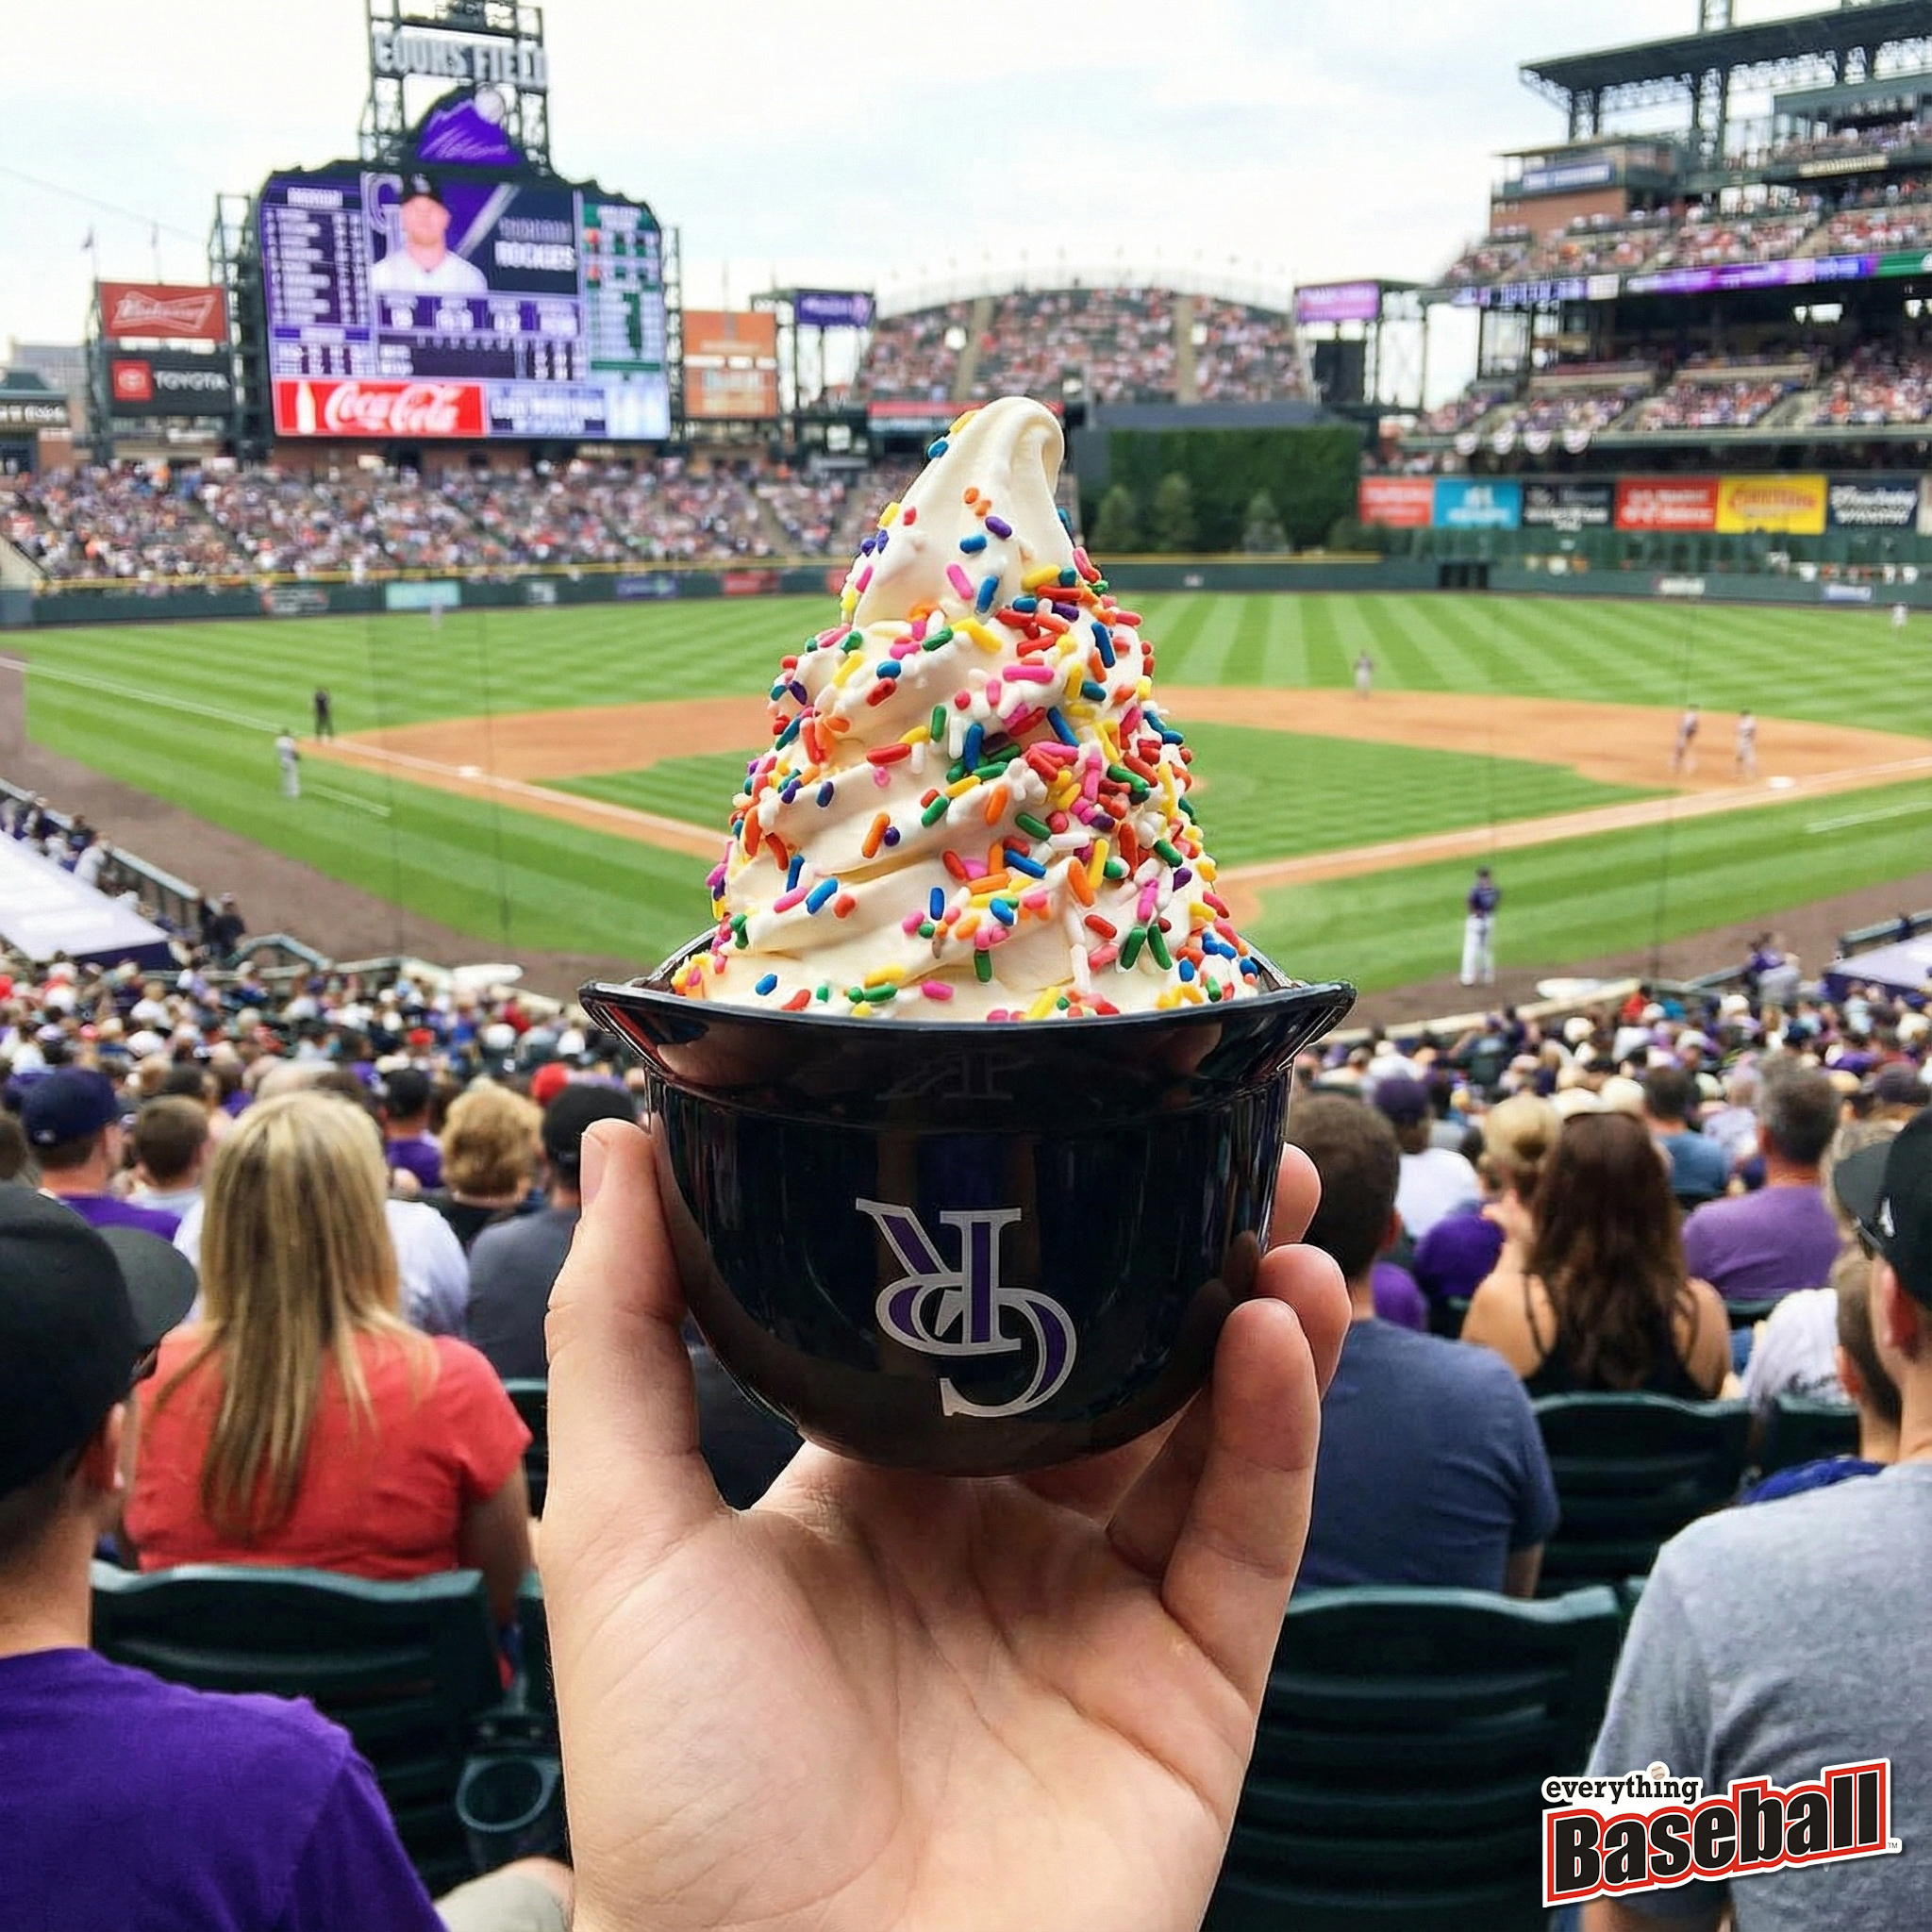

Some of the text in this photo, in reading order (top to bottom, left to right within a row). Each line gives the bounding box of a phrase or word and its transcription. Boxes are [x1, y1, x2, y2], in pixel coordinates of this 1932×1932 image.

[374, 32, 547, 89] COORS FIELD
[153, 370, 230, 391] TOYOTA
